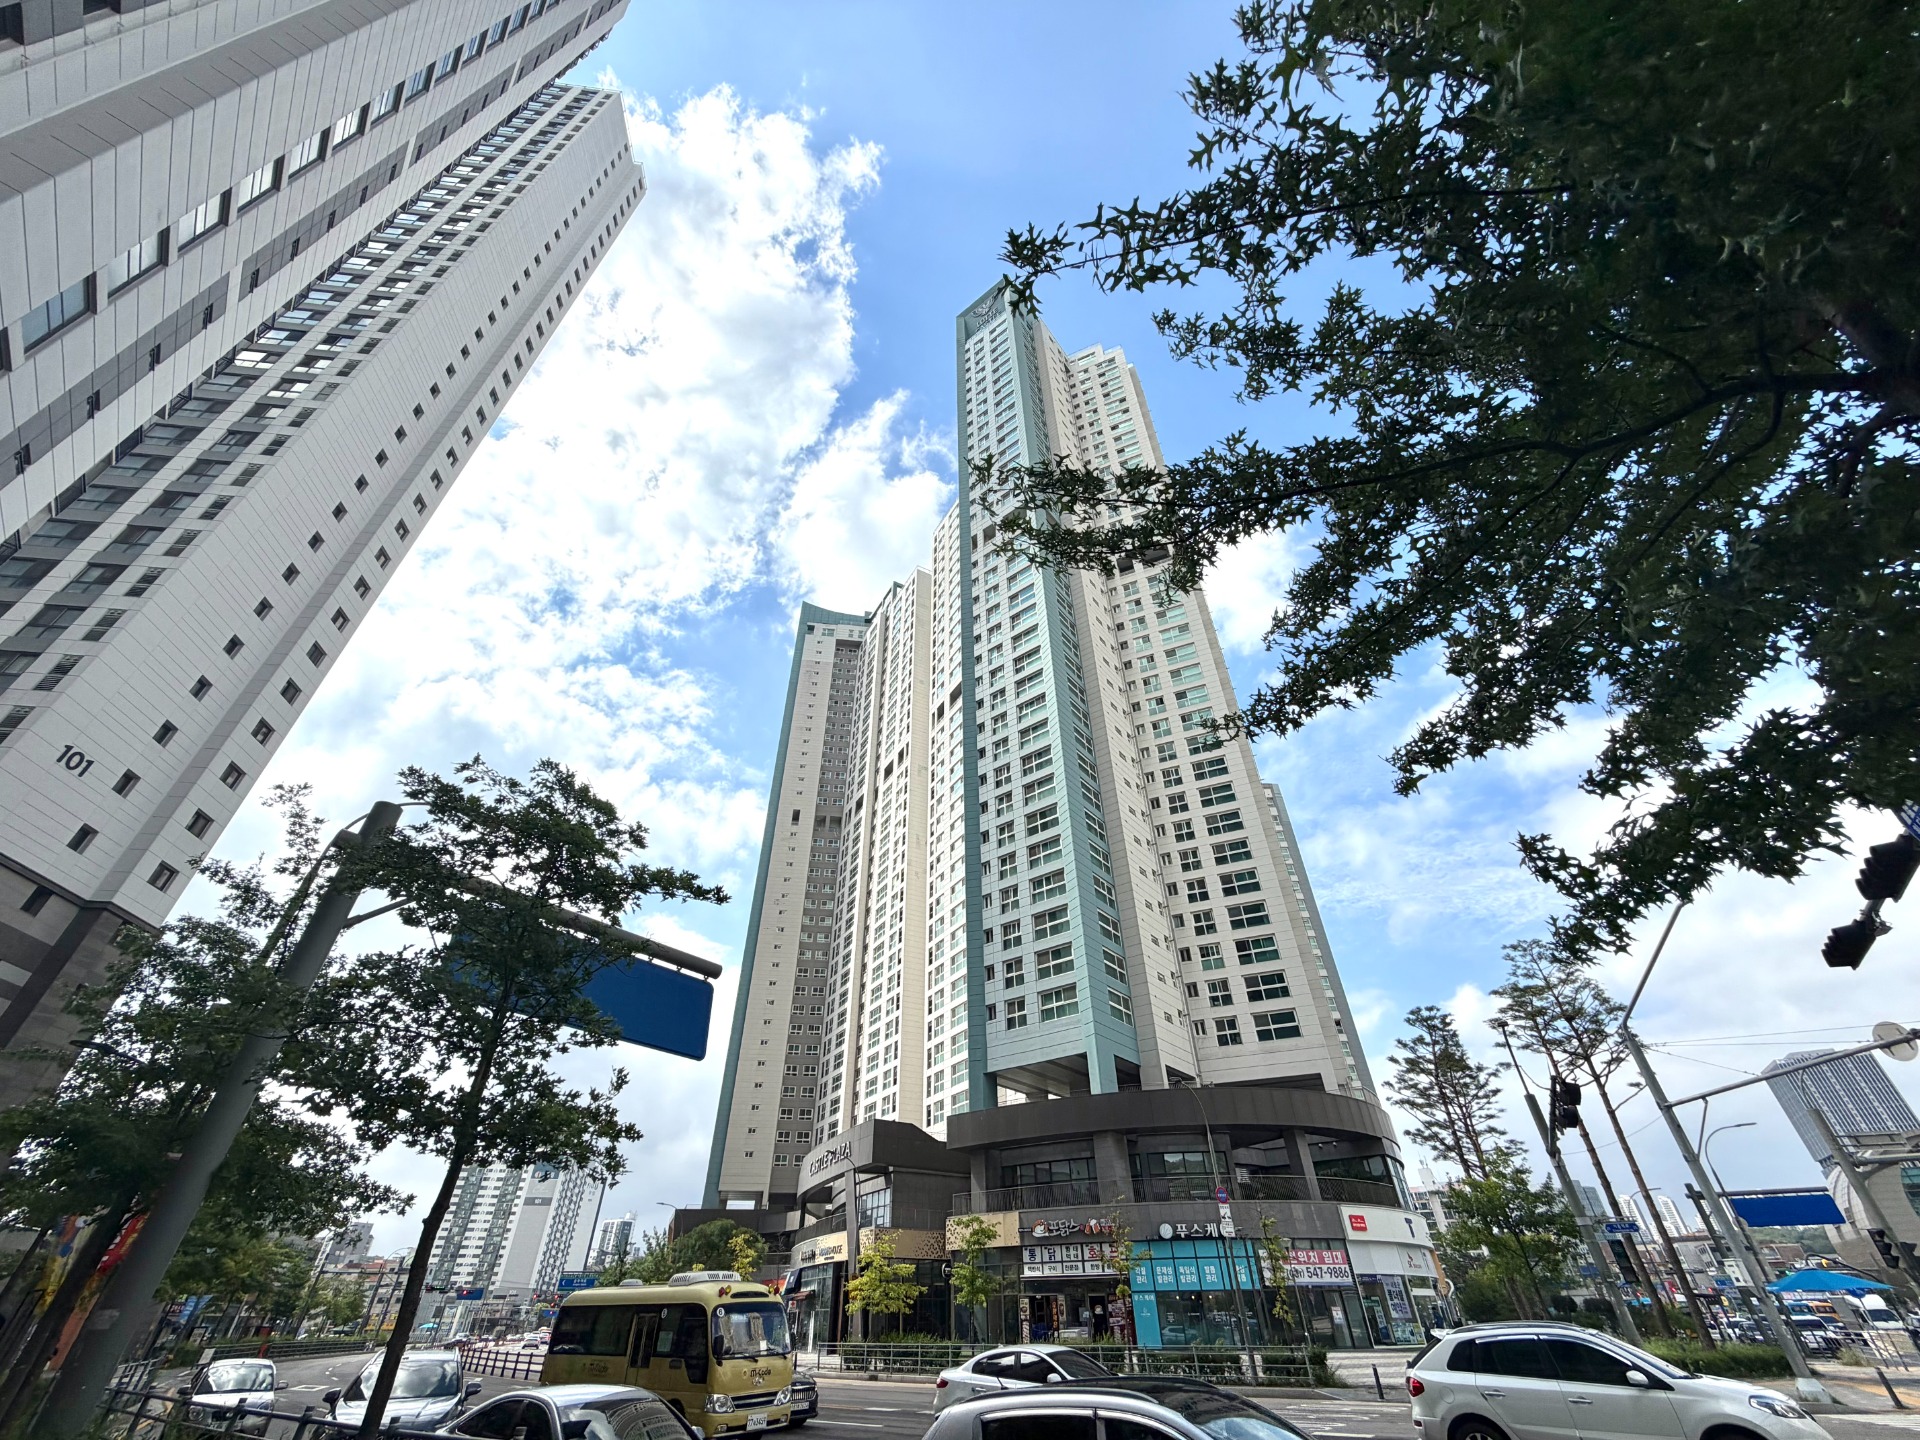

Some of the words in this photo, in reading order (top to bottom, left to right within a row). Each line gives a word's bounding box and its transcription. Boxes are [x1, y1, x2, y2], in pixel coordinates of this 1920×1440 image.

[56, 745, 95, 777] 101
[808, 1151, 828, 1177] CASTLE
[828, 1141, 852, 1166] PLAZA
[1322, 1251, 1343, 1264] 임대
[1156, 1266, 1173, 1275] 문제성
[1306, 1266, 1350, 1279] 547-9886
[1136, 1275, 1148, 1284] 관리
[1157, 1275, 1174, 1284] 발관리
[1180, 1274, 1197, 1283] 발관리
[1205, 1274, 1218, 1283] 관리
